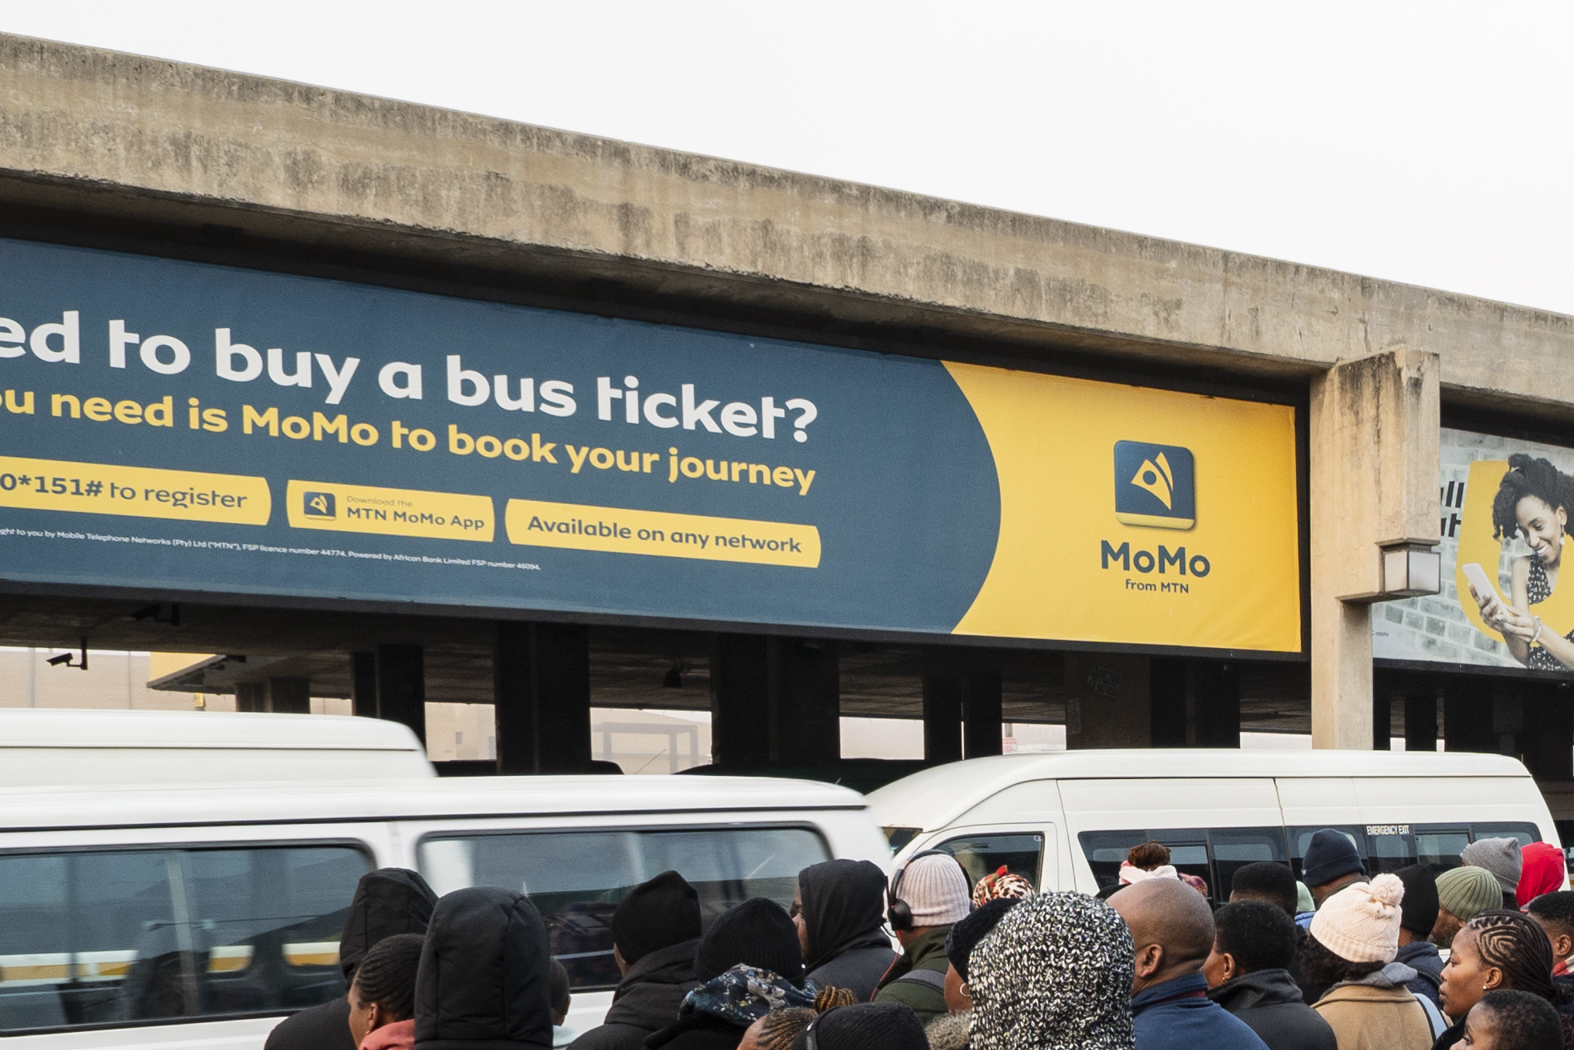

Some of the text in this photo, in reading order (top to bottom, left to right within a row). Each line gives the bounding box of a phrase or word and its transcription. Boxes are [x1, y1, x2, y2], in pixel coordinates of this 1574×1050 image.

[108, 319, 191, 376] to
[215, 328, 361, 404] buy
[378, 361, 423, 400] a
[446, 355, 577, 418] bus
[597, 375, 818, 443] ticket?
[0, 389, 816, 496] u need is MoMo to book your journey
[110, 482, 136, 500] to
[144, 486, 248, 509] register
[346, 496, 413, 508] Download the
[347, 507, 485, 530] MTN MoMo App
[527, 515, 802, 554] Available on any network
[45, 530, 55, 539] by
[57, 531, 85, 540] Mobile
[86, 533, 130, 543] Telephone
[132, 536, 171, 546] Networks
[173, 538, 192, 548] (Pty)
[193, 540, 206, 548] Ltd
[243, 543, 259, 551] FSP
[260, 545, 287, 553] licence
[289, 547, 319, 555] number
[349, 551, 382, 560] Powered
[383, 553, 392, 561] by
[394, 553, 421, 563] African
[423, 556, 443, 564] Bank
[444, 556, 471, 566] Limited
[488, 561, 515, 569] number
[1101, 540, 1211, 578] MoMo
[1125, 578, 1189, 594] from MTN
